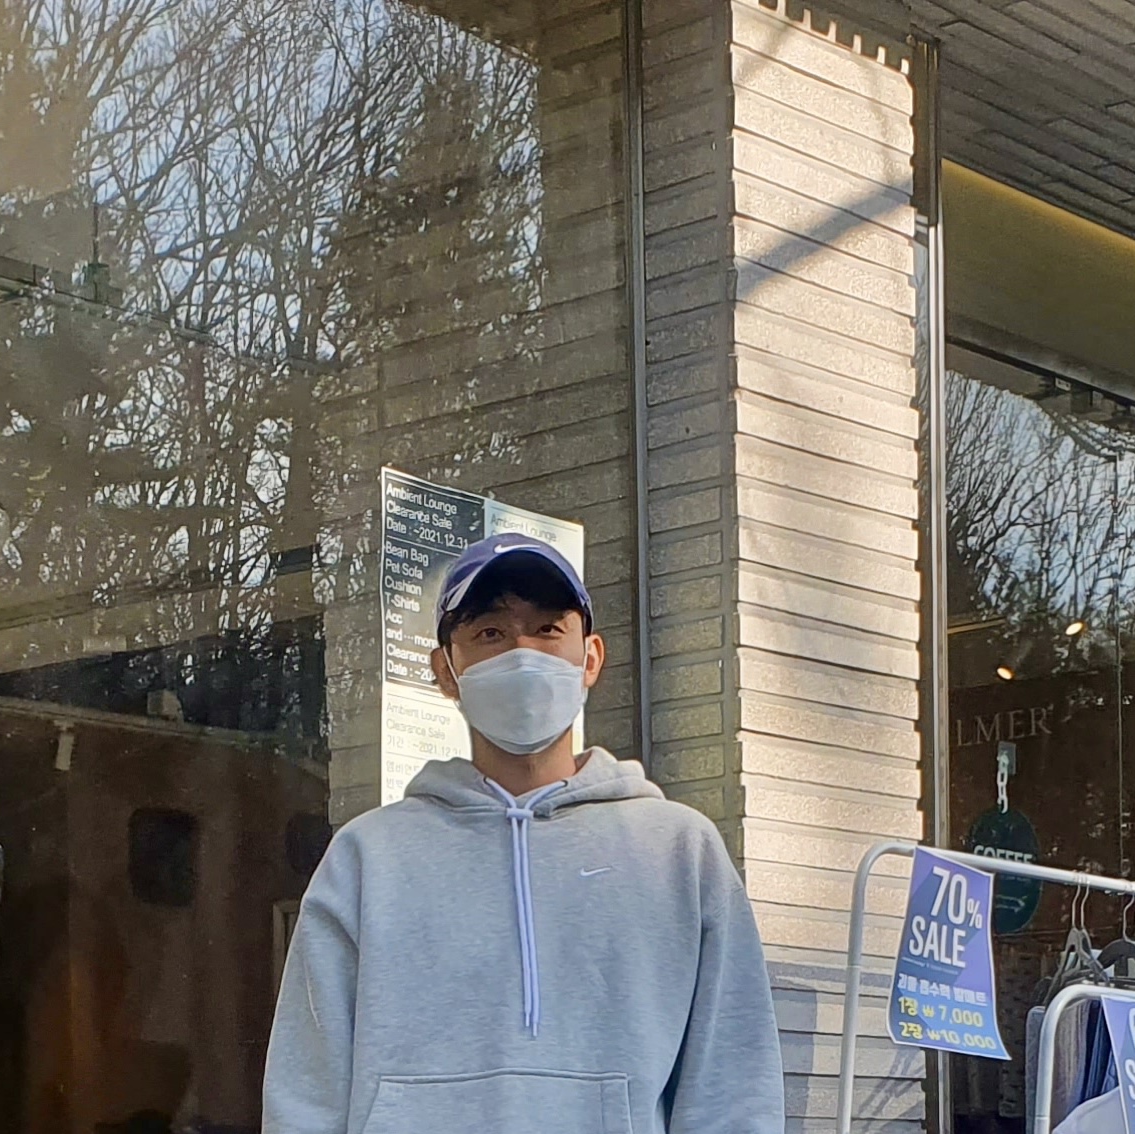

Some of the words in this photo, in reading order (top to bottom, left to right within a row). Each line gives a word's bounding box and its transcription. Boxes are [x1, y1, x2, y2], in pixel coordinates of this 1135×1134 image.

[386, 483, 422, 502] Ambient
[424, 493, 458, 515] Lounge
[386, 501, 430, 524] Clearance
[432, 512, 453, 530] Sale
[386, 517, 407, 534] Date
[386, 541, 408, 559] Bean
[411, 548, 429, 567] Bag
[402, 564, 423, 580] Sofa
[385, 575, 422, 596] Cushion
[385, 592, 420, 613] T-Shirts
[386, 608, 403, 625] Acc
[386, 628, 402, 641] and
[387, 659, 407, 676] Date
[931, 866, 983, 929] 70%
[909, 915, 966, 968] SALE
